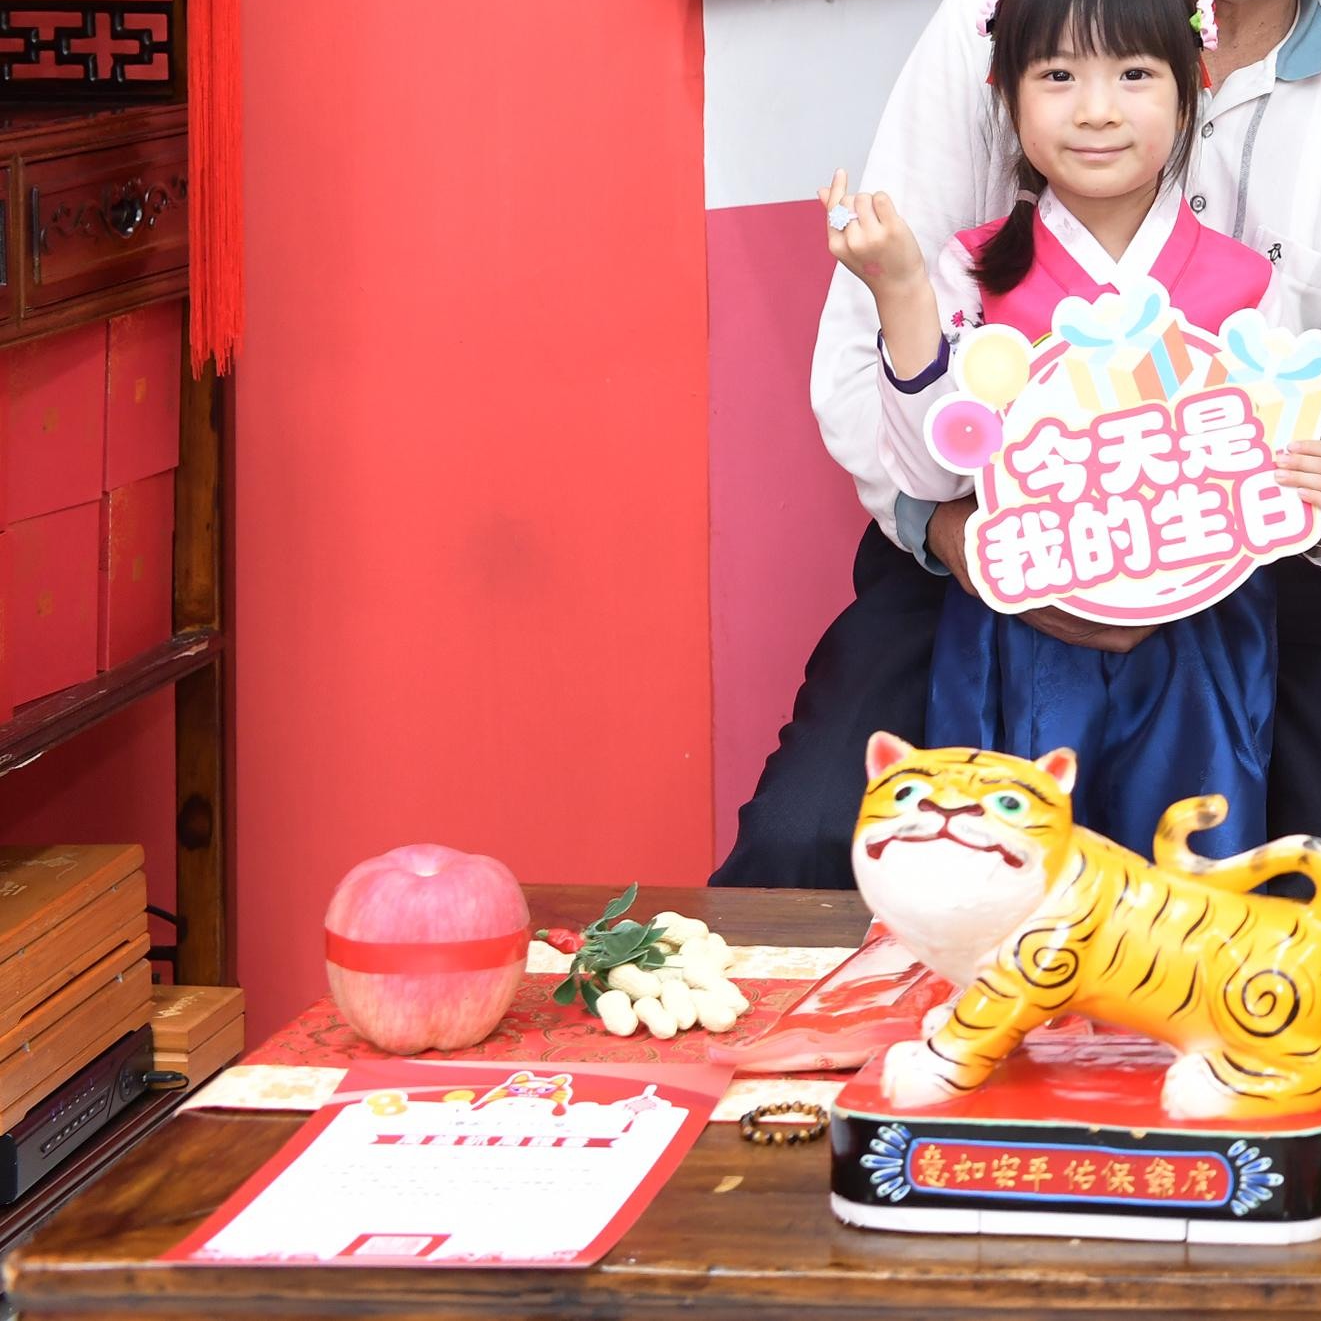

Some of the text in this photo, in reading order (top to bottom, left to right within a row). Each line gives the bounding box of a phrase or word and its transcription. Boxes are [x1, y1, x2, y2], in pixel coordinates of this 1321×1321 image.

[1010, 393, 1266, 503] 今天是
[984, 470, 1307, 596] 我的生日
